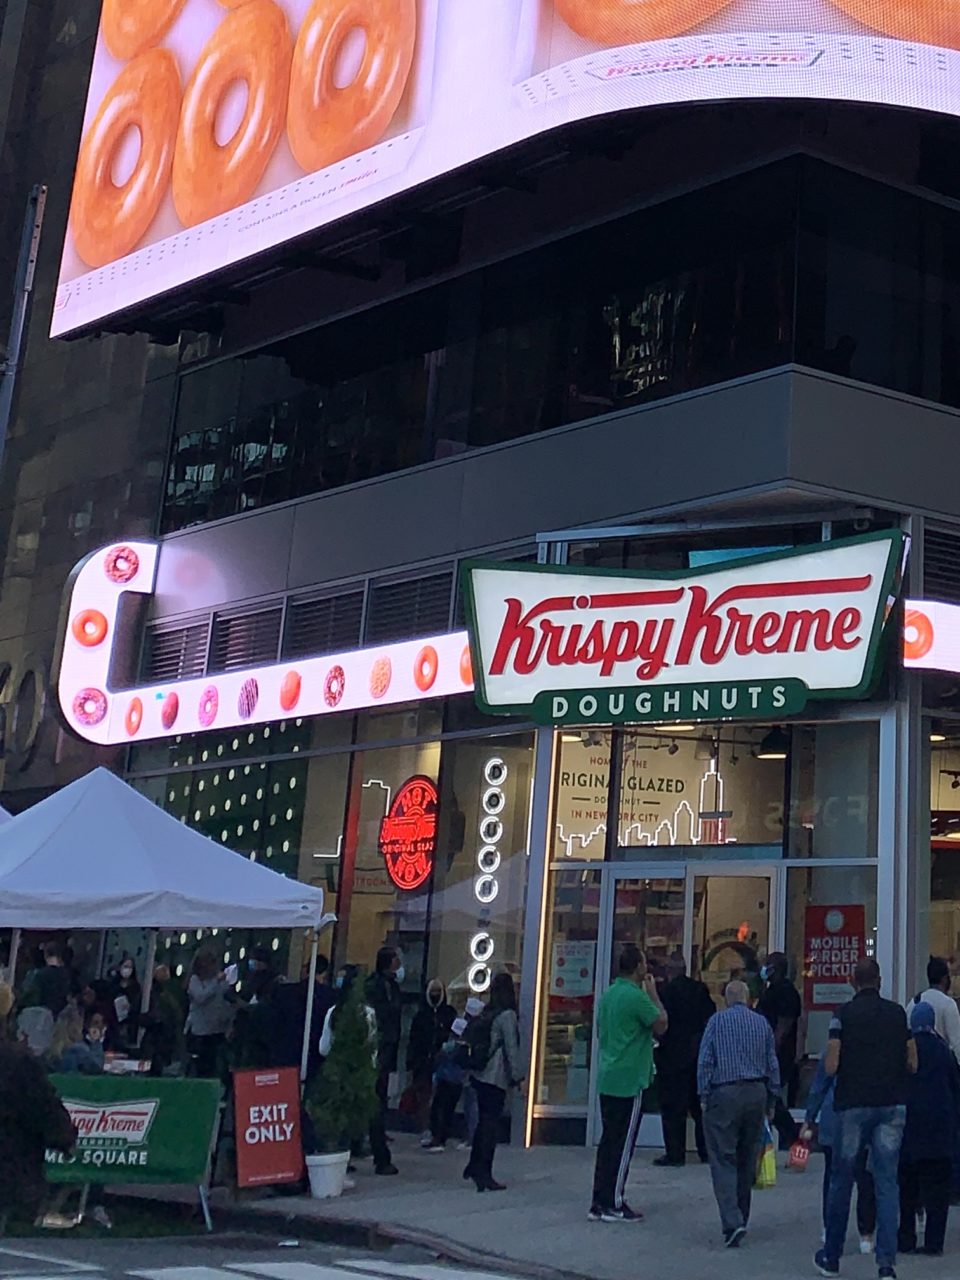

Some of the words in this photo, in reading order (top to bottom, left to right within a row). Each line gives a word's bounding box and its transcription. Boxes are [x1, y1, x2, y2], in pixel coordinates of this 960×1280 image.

[489, 587, 685, 681] Krispy
[675, 574, 872, 666] Kreme
[552, 686, 786, 718] DOUGHNUTS
[627, 776, 685, 794] GLAZED
[571, 809, 582, 818] IN
[638, 813, 660, 822] CITY
[810, 936, 859, 950] MOBILE
[96, 1110, 149, 1132] Kreme
[249, 1103, 288, 1124] EXIT
[244, 1122, 294, 1145] ONLY
[81, 1149, 148, 1167] SQUARE
